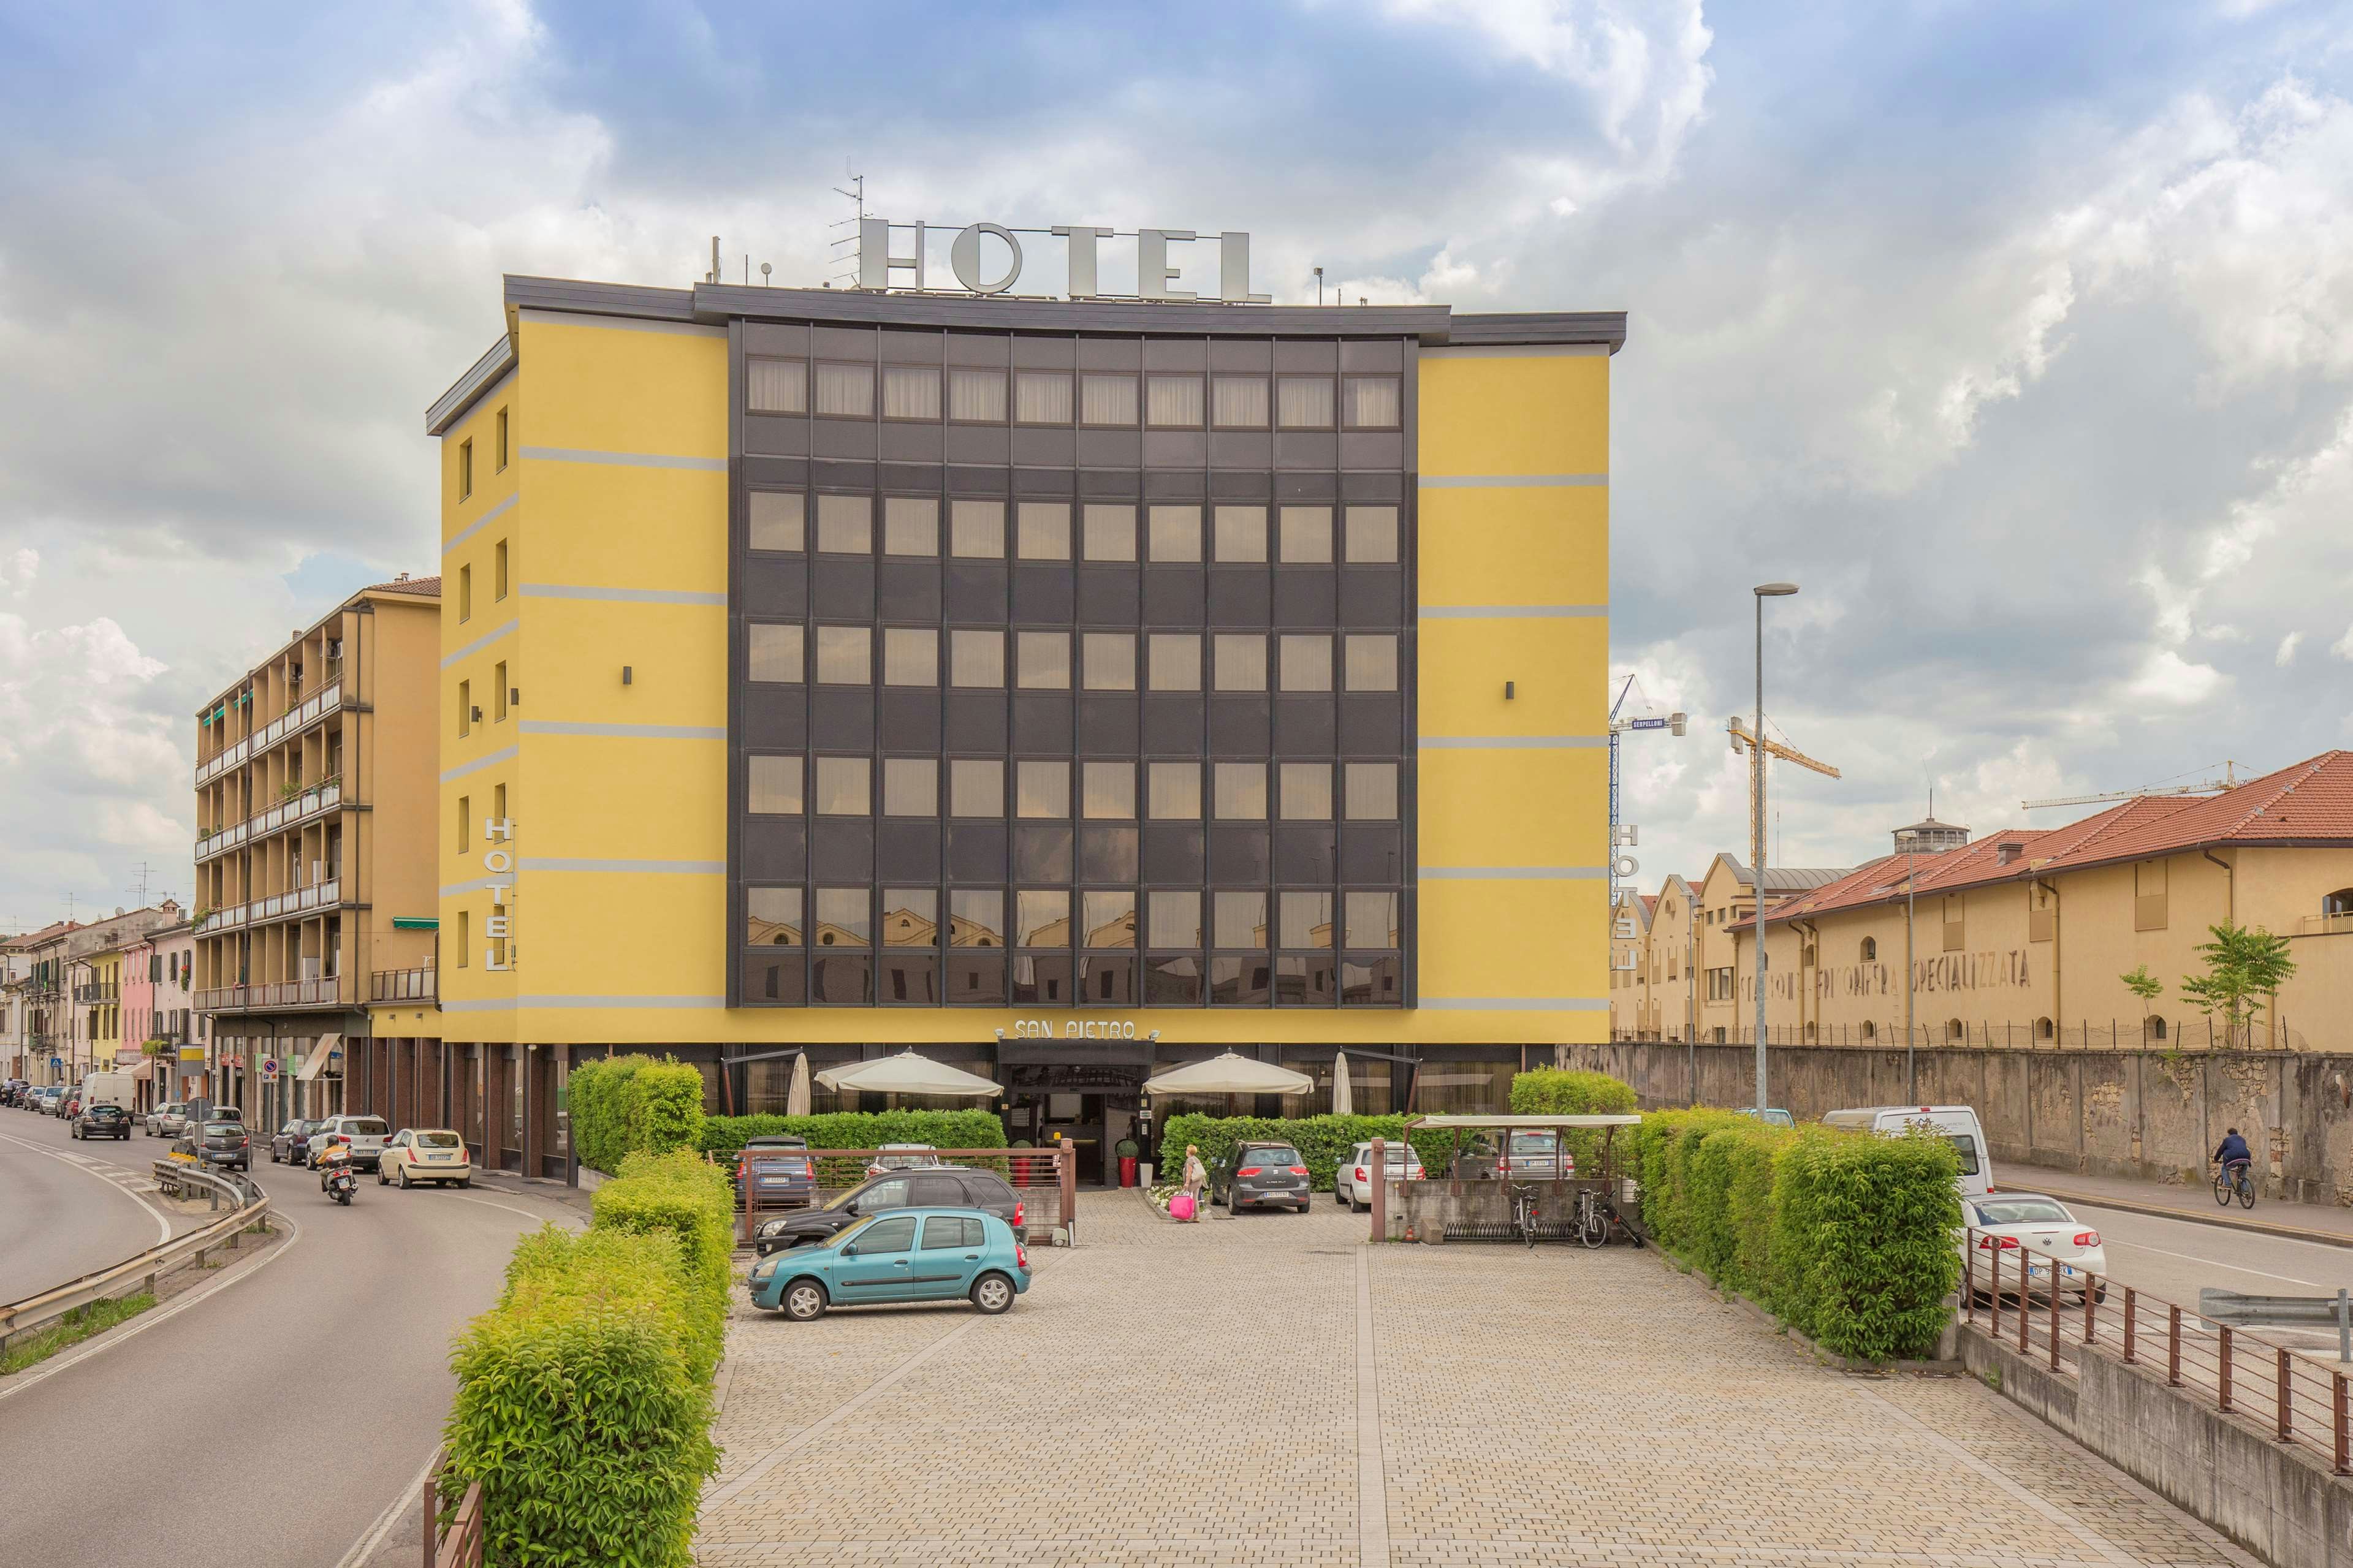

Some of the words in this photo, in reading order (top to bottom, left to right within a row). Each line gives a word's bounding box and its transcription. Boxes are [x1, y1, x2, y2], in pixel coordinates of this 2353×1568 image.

[860, 219, 1272, 304] HOTEL
[484, 818, 512, 971] HOTEL
[1913, 949, 2031, 993] SPECIALIZZATA
[1015, 1020, 1052, 1039] SAN
[1066, 1020, 1134, 1039] PIETRO
